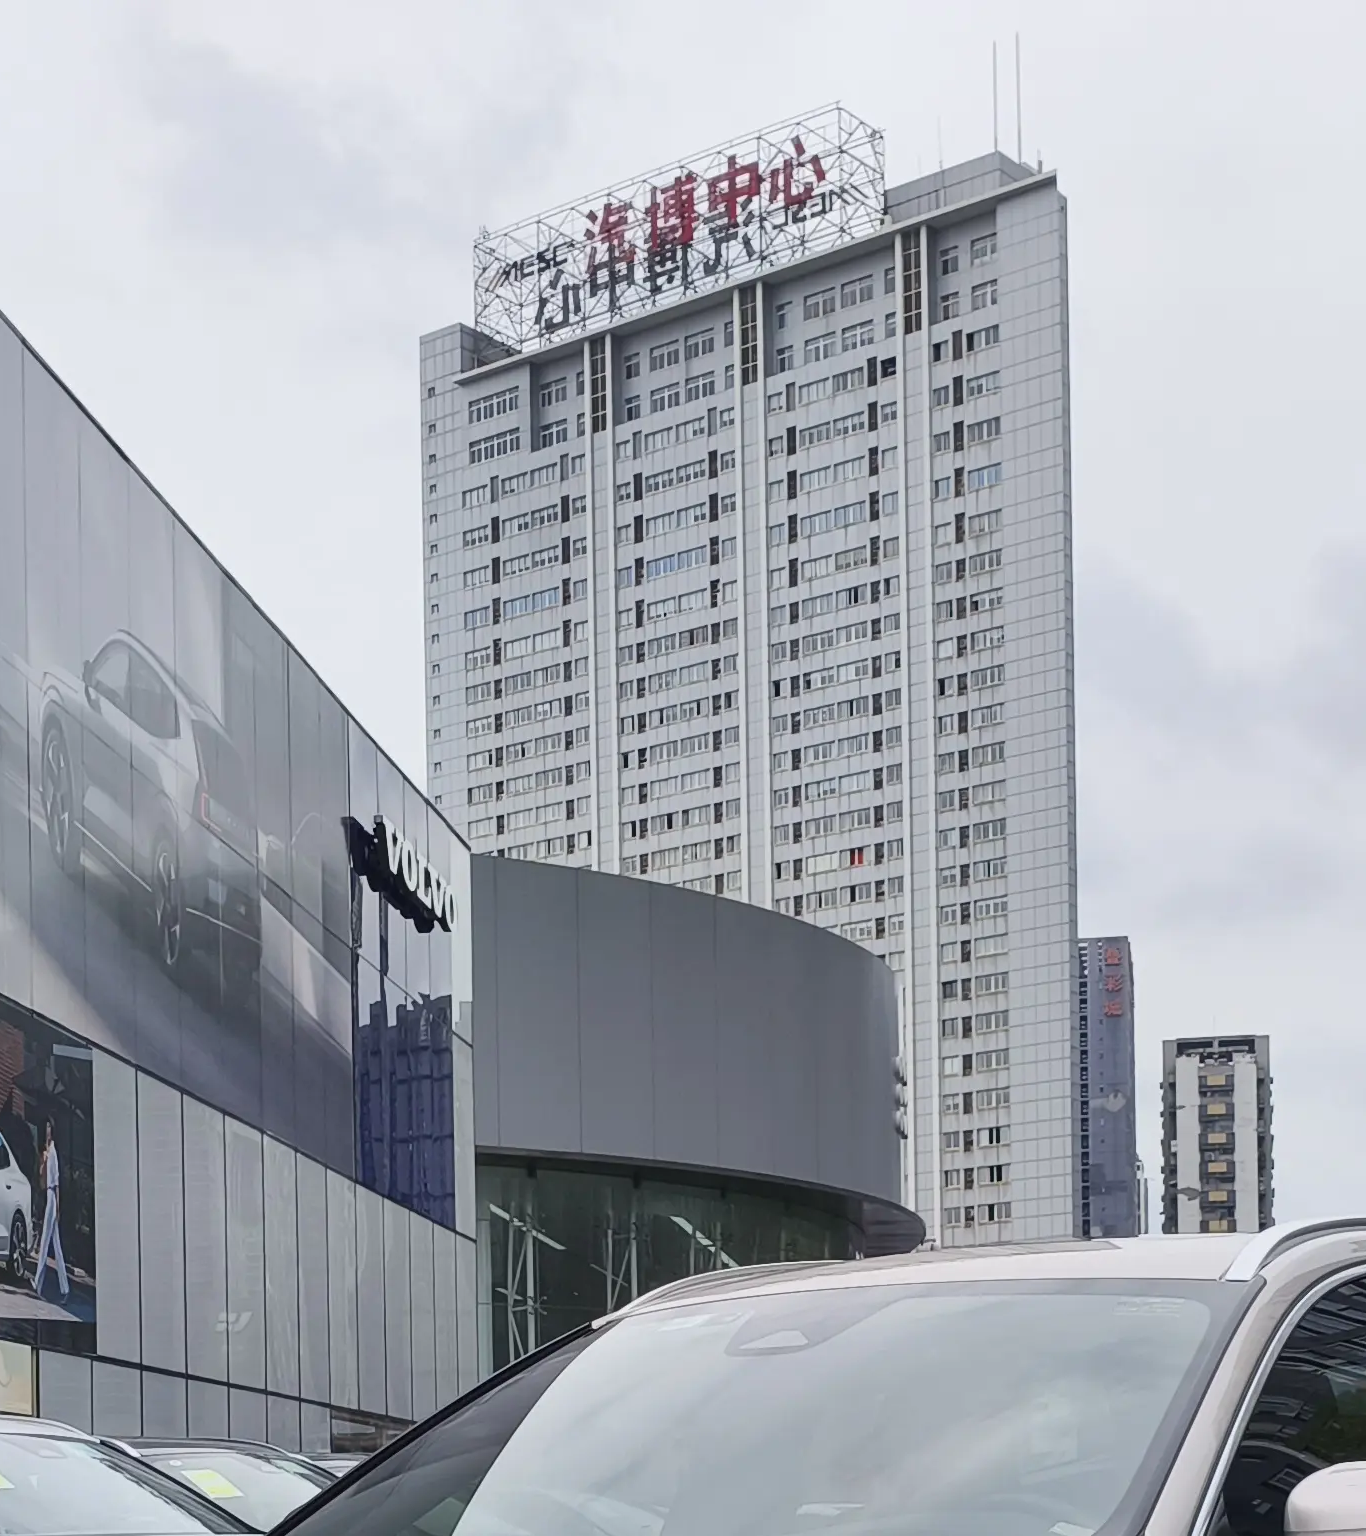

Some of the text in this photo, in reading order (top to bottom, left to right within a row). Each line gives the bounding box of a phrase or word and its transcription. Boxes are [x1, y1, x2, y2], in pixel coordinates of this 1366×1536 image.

[583, 135, 826, 276] 汽博中心
[382, 815, 457, 931] VOLVO
